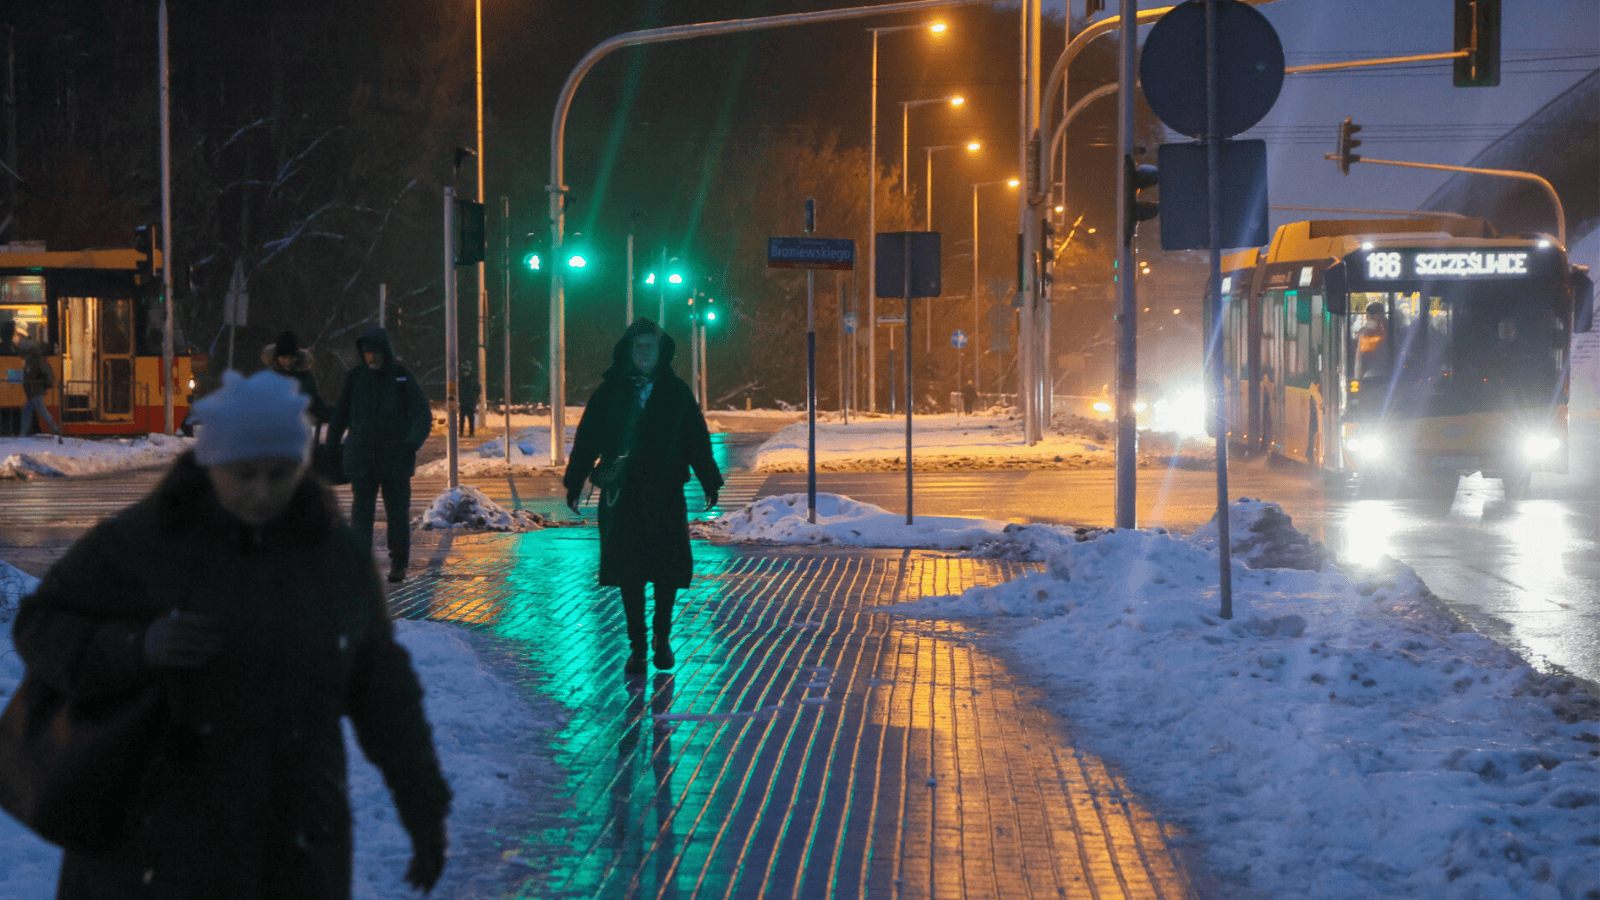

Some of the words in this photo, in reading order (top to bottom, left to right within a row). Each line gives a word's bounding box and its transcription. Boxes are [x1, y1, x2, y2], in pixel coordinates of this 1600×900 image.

[771, 245, 851, 261] Broniewskiego
[1366, 252, 1400, 278] 186
[1415, 252, 1527, 275] SZCZĘŚLIWICE
